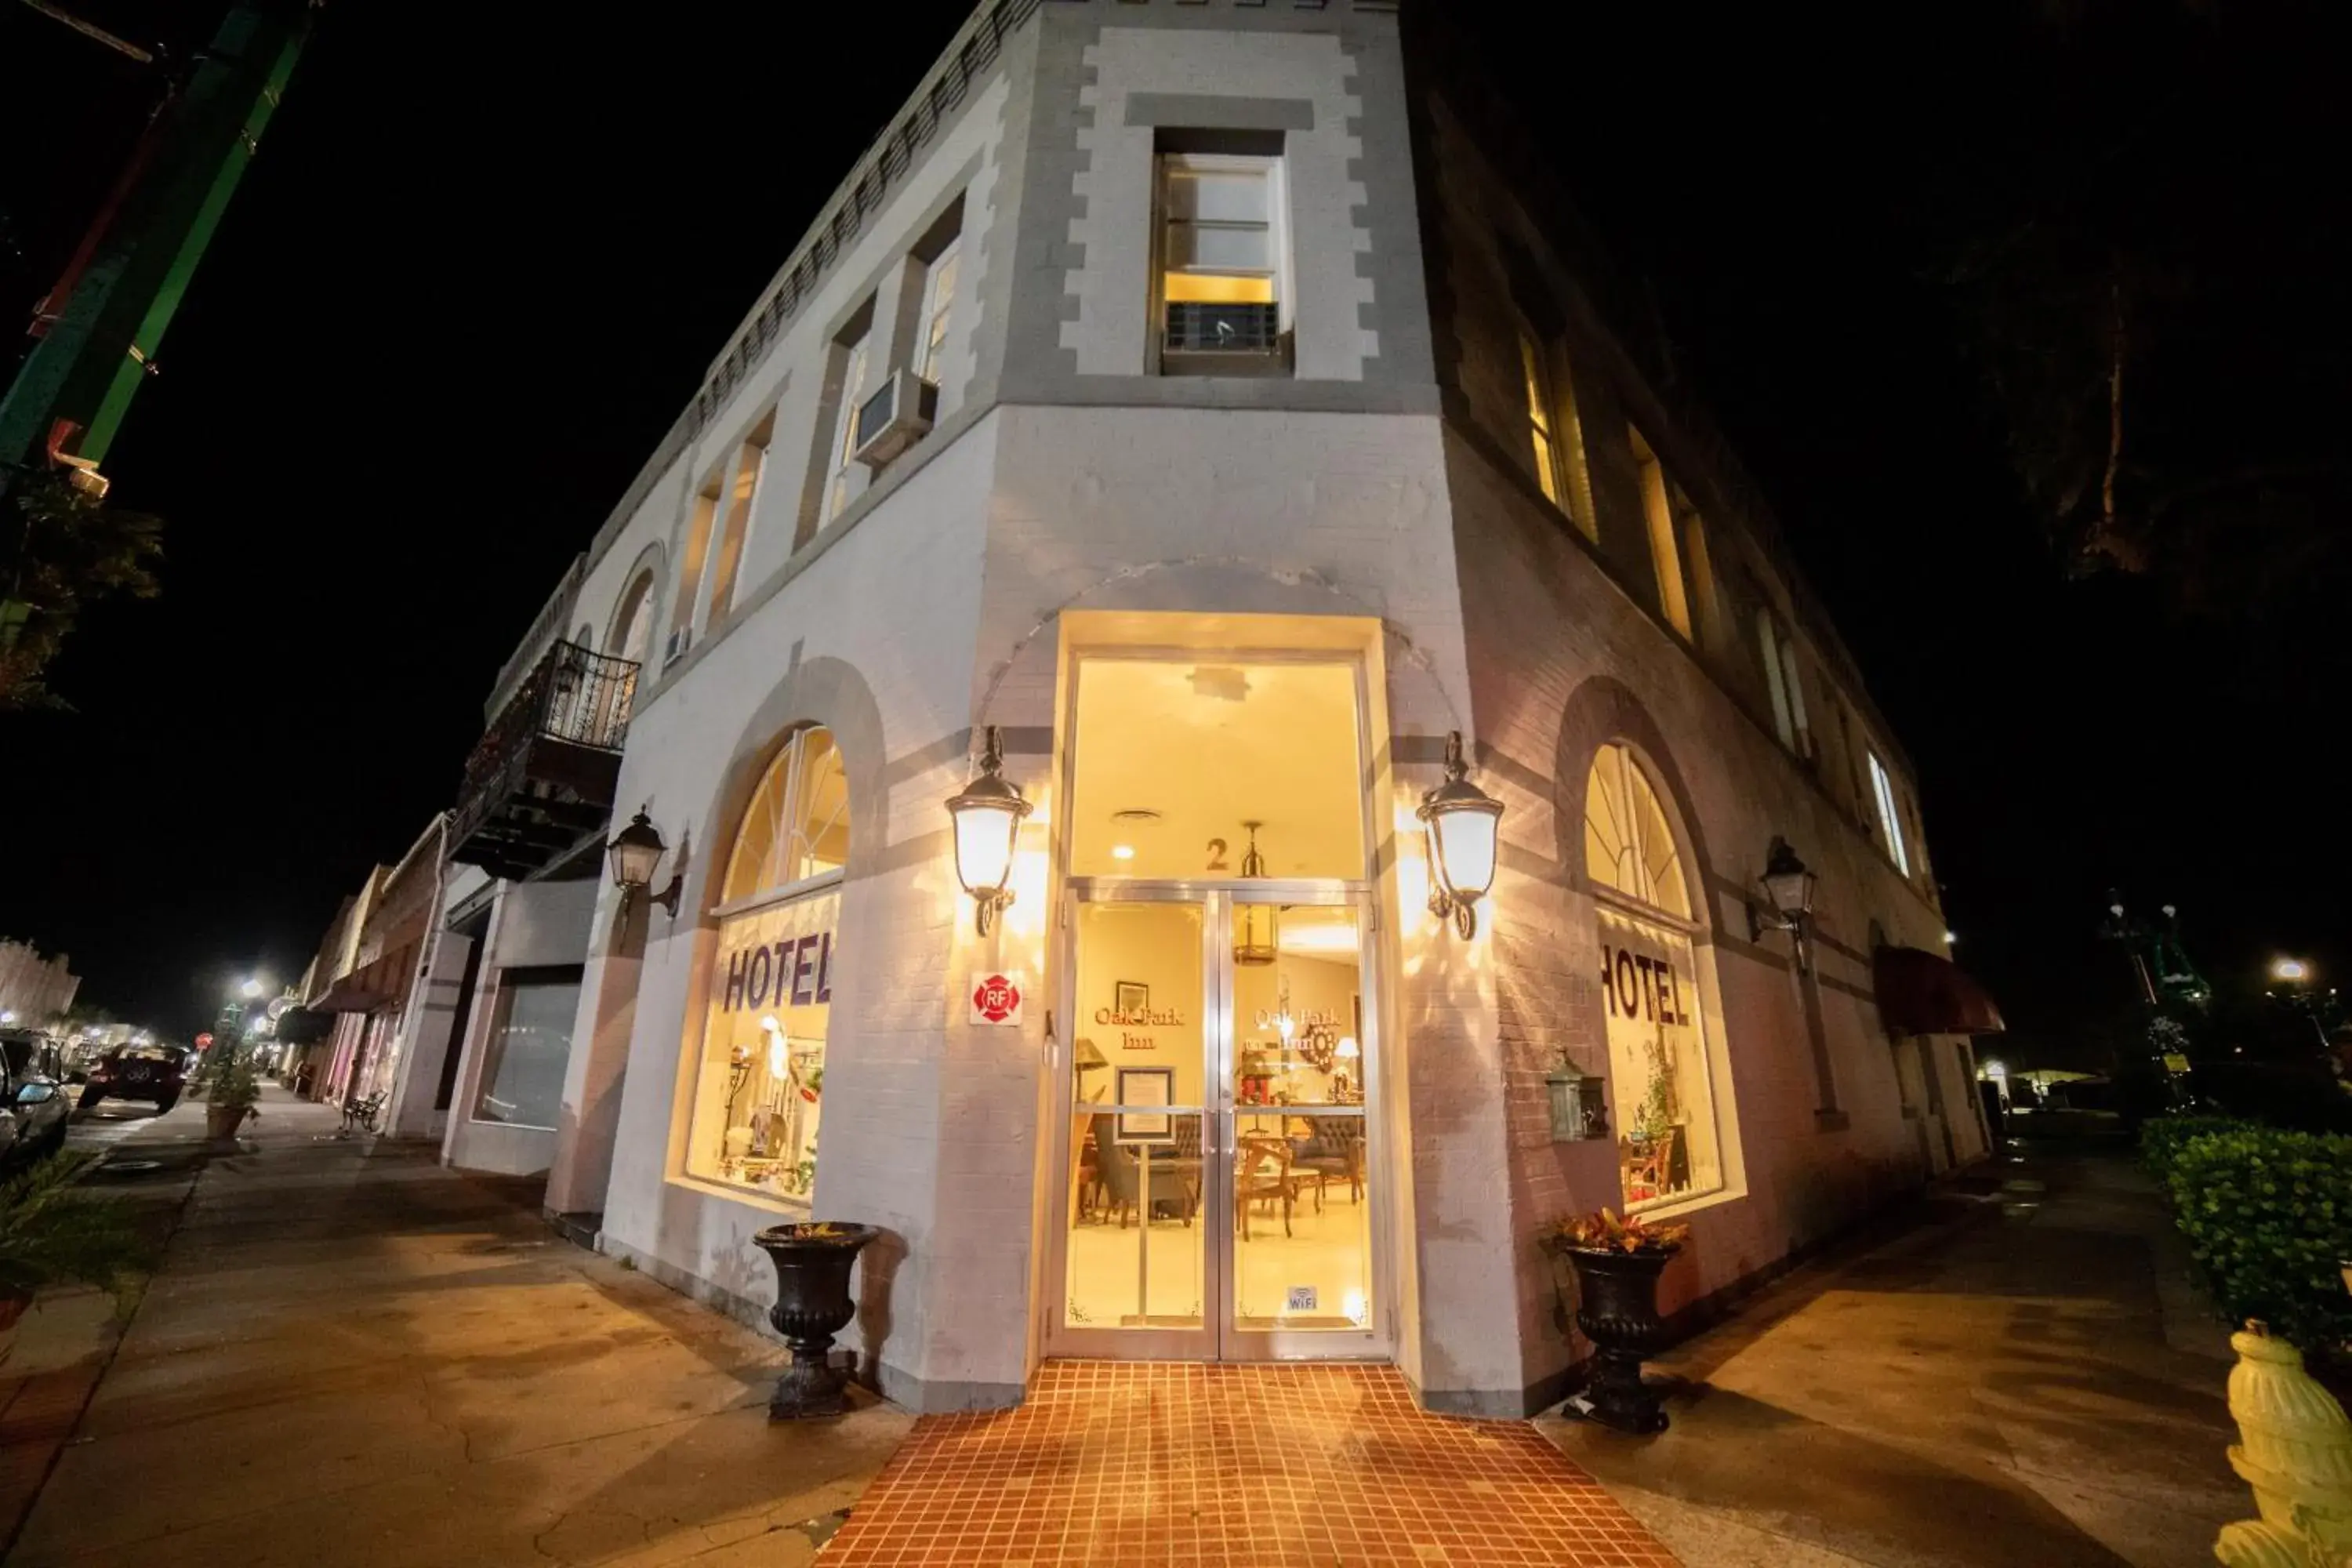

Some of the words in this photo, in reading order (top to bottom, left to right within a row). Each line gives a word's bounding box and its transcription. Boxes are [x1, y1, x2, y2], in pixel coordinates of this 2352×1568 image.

[1207, 838, 1229, 870] 2
[724, 932, 831, 1013] HOTEL
[987, 990, 1007, 1007] RF
[1095, 1007, 1134, 1026] Oak
[1254, 1008, 1294, 1026] Oak
[1299, 1007, 1343, 1025] Park
[1123, 1032, 1156, 1050] Inn
